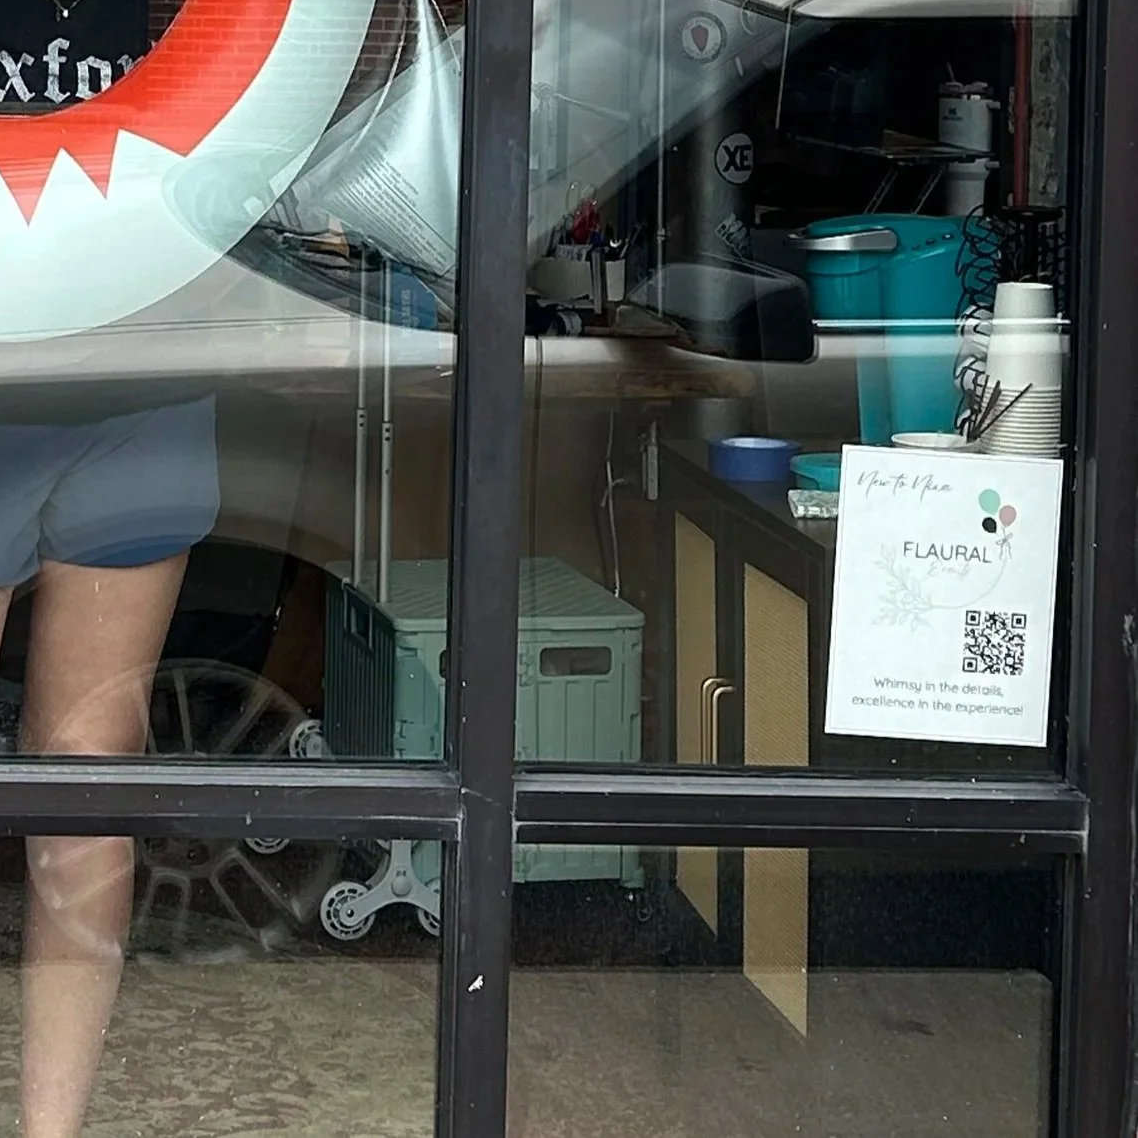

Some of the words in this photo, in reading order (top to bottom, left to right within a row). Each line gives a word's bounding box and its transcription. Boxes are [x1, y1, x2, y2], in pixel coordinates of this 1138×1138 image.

[903, 540, 992, 563] FLAURAL
[873, 676, 922, 694] Whimsy
[925, 680, 936, 693] in
[939, 682, 959, 694] the
[851, 694, 915, 709] excellence
[918, 698, 929, 710] in
[932, 700, 952, 712] the
